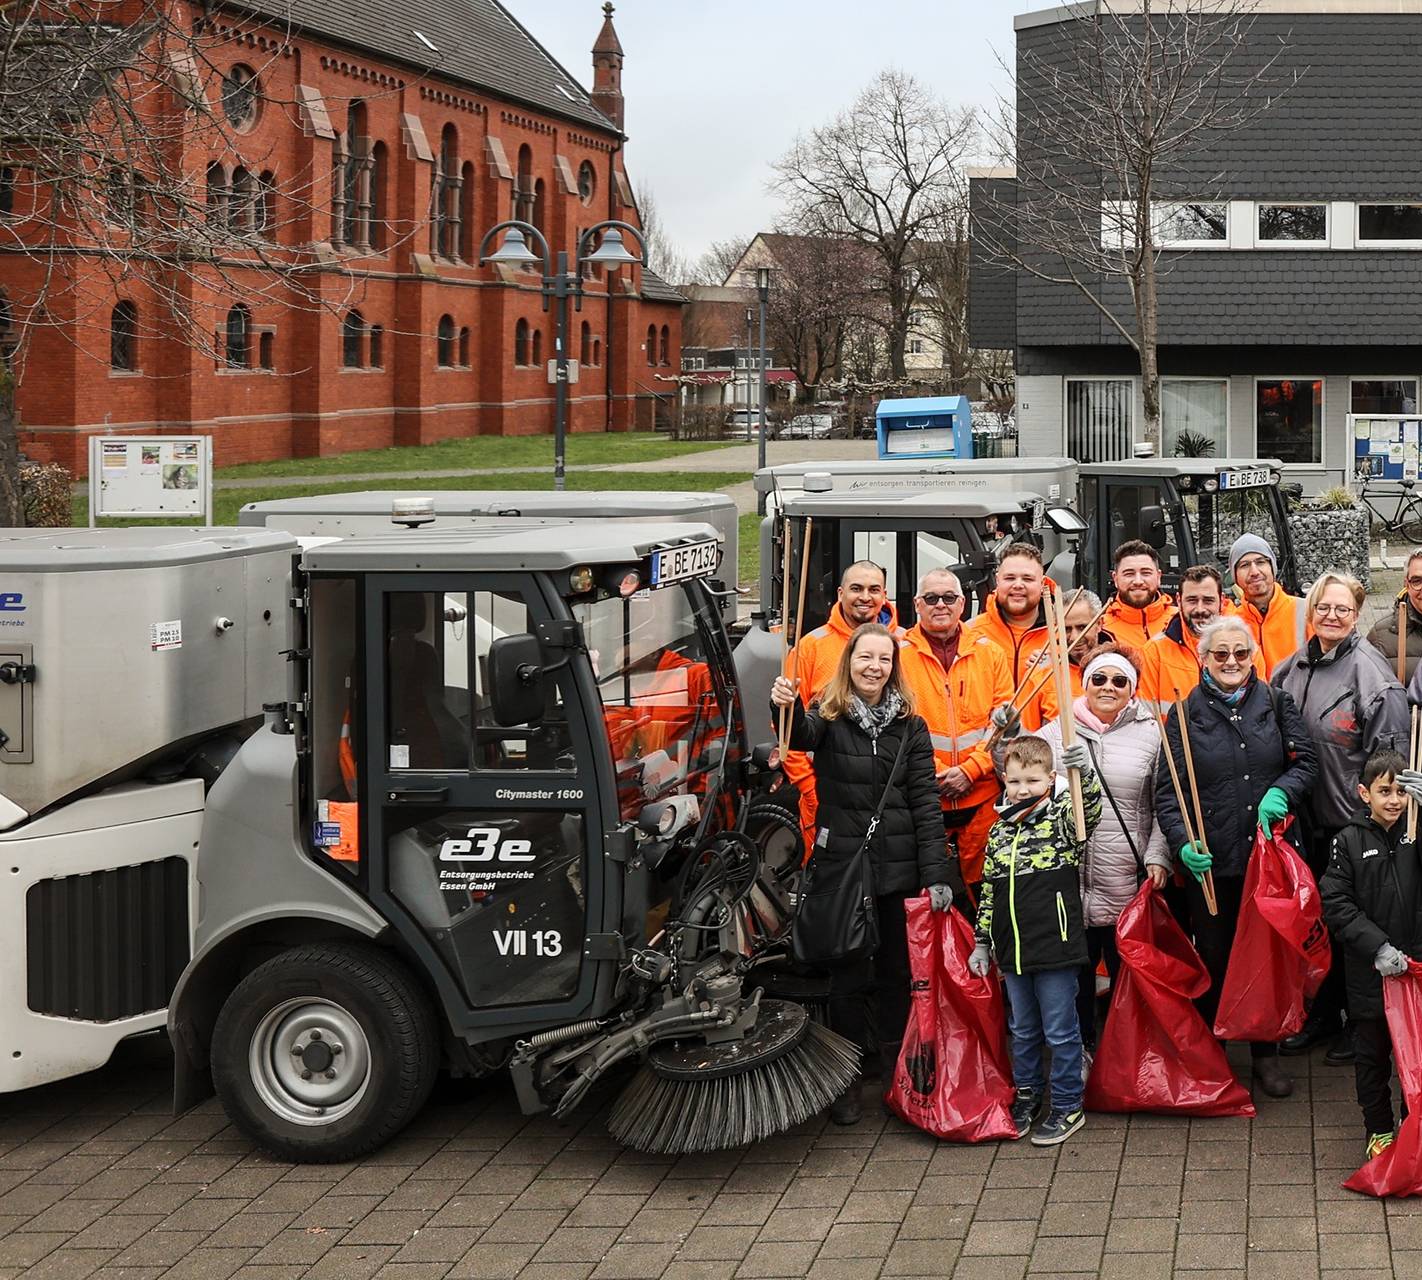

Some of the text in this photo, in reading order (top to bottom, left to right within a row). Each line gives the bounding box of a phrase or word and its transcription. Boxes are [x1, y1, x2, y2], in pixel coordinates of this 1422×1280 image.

[1229, 470, 1267, 487] E BE 738
[660, 544, 716, 579] E BE 7132
[495, 789, 584, 800] Citymaster 1600
[439, 828, 536, 862] e3e
[439, 870, 535, 880] Entsorgungsbetriebe
[439, 882, 496, 891] Essen GmbH
[532, 929, 563, 957] 13
